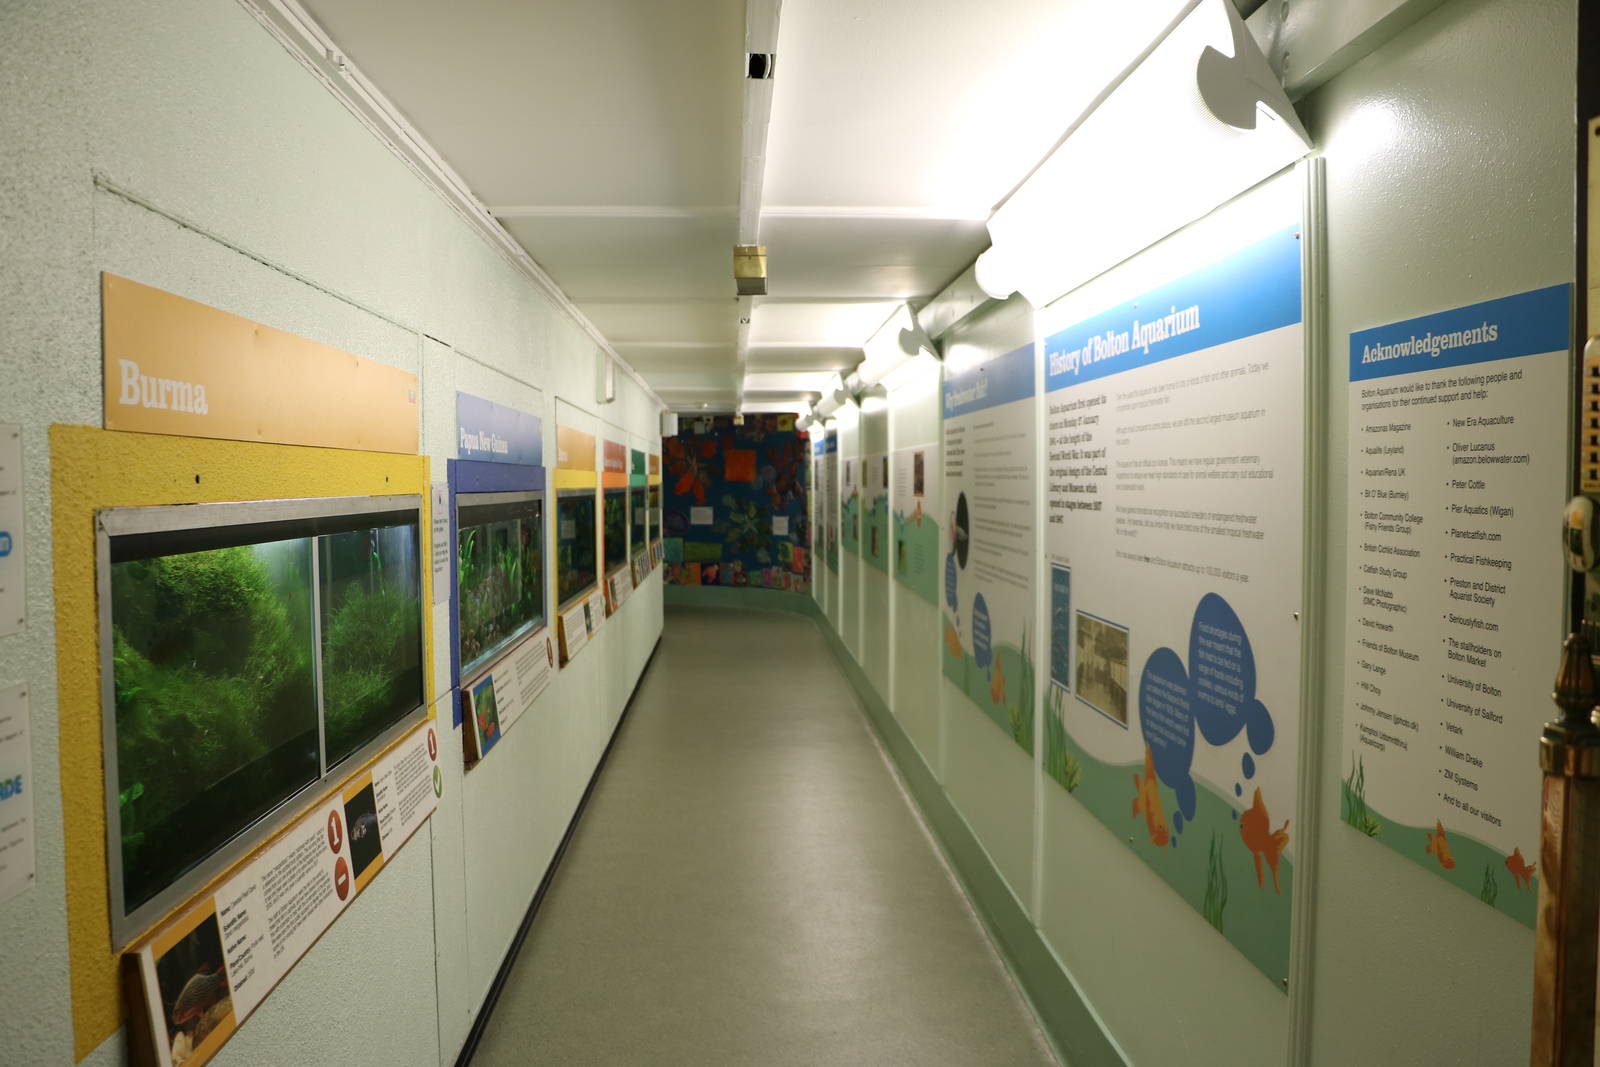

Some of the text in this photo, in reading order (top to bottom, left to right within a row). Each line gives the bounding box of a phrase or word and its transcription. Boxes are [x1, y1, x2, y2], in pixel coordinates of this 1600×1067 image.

[1050, 304, 1200, 376] History of Bolton Aquarium
[1362, 322, 1498, 364] Acknowledgements
[118, 358, 208, 415] Burma
[1400, 383, 1414, 394] would
[1415, 382, 1424, 392] like
[1425, 382, 1431, 390] to
[1432, 380, 1447, 390] thank
[1448, 378, 1457, 387] the
[1458, 373, 1485, 387] following
[1486, 370, 1508, 384] people
[1509, 368, 1522, 380] and
[1362, 400, 1391, 412] organisations
[1400, 396, 1411, 407] their
[1411, 394, 1437, 405] continued
[1438, 392, 1460, 405] support
[1460, 390, 1472, 400] and
[1473, 388, 1488, 401] help:
[1453, 416, 1514, 428] New Era Aquaculture
[1452, 442, 1495, 452] Oliver Lucanus
[1452, 454, 1530, 466] (amazon.belowwater.com)
[1452, 480, 1485, 489] Peter Cottle
[1405, 513, 1423, 525] College
[1451, 504, 1514, 518] Pier Aquatics (Wigan)
[1451, 528, 1502, 541] Planetcatfish.com
[1394, 547, 1420, 557] Association
[1450, 553, 1512, 571] Practical Fishkeeping
[1380, 566, 1391, 578] Study
[1393, 568, 1408, 580] Group
[1450, 577, 1506, 594] Preston and District
[1449, 589, 1495, 608] Aquarist Society
[1448, 613, 1499, 632] Seriouslyfish.com
[1448, 637, 1502, 658] The stallholders on
[1448, 649, 1487, 668] Bolton Market
[1447, 674, 1502, 697] University of Bolton
[1446, 698, 1503, 724] University of Salford
[1445, 722, 1463, 736] Vetark
[1445, 745, 1484, 768] William Drake
[1454, 774, 1478, 791] Systems
[1443, 793, 1454, 804] And
[1470, 807, 1479, 816] our
[1480, 810, 1502, 827] visitors
